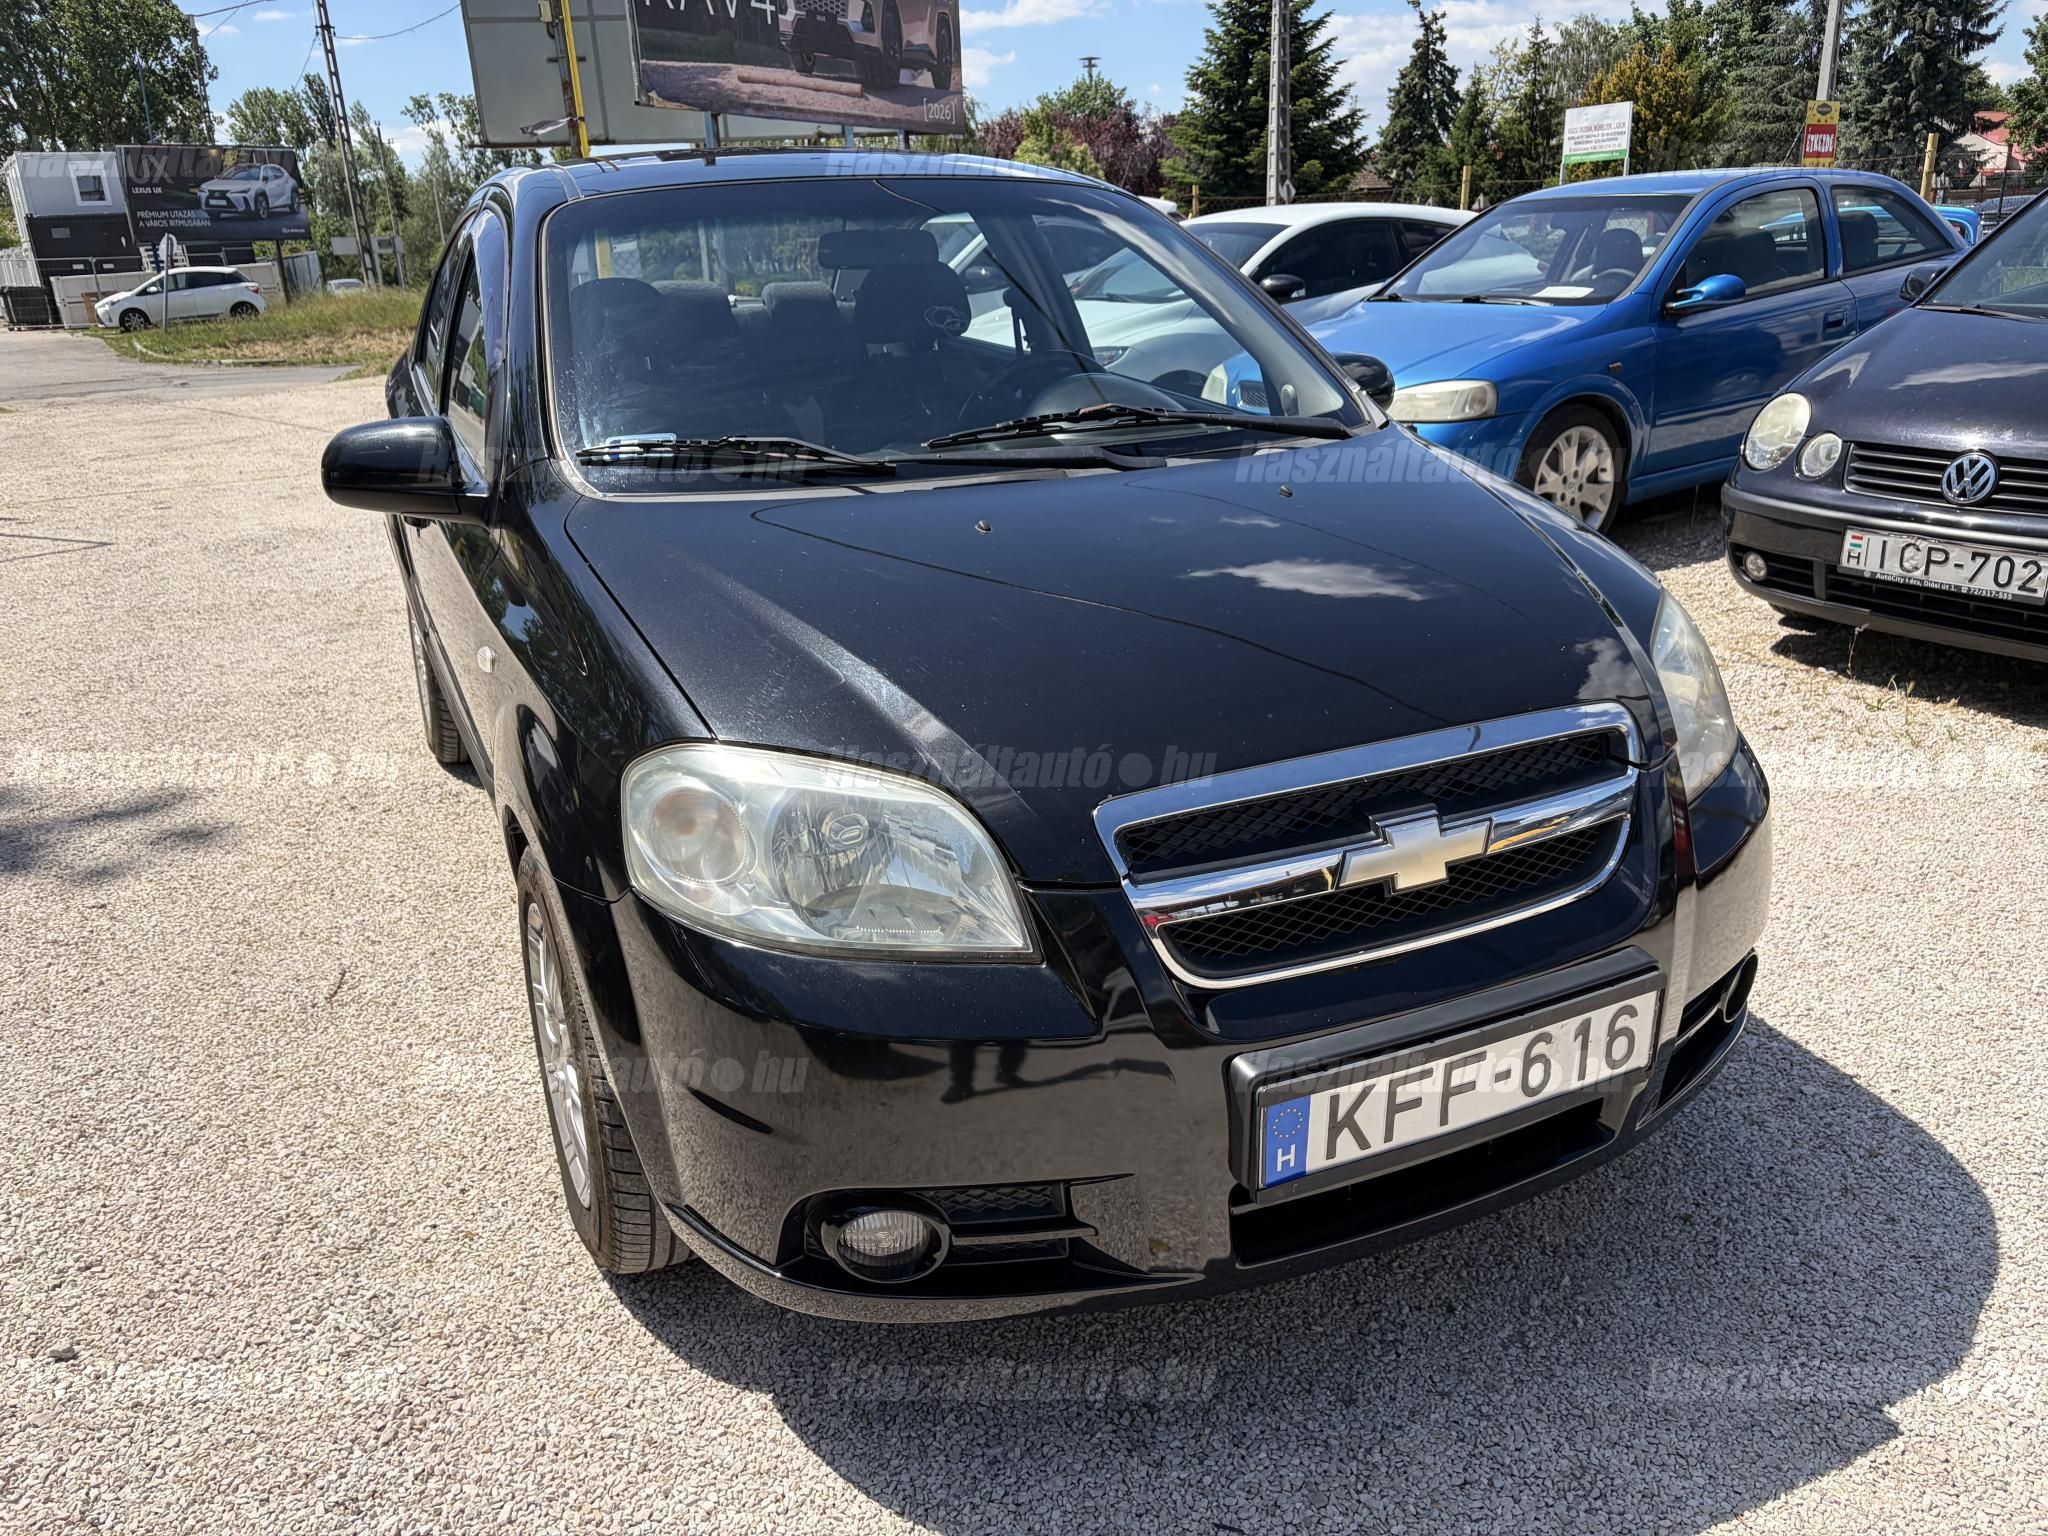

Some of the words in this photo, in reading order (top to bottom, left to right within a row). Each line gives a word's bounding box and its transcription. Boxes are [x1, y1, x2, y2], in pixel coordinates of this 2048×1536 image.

[136, 209, 168, 219] PRÉMIUM
[170, 209, 196, 218] UTAZÁS
[145, 219, 168, 227] VÁROS
[1879, 540, 2043, 594] ICP-702
[1875, 573, 1905, 584] AutoCity
[1276, 1144, 1296, 1172] H
[1325, 1004, 1639, 1160] KFF-616
